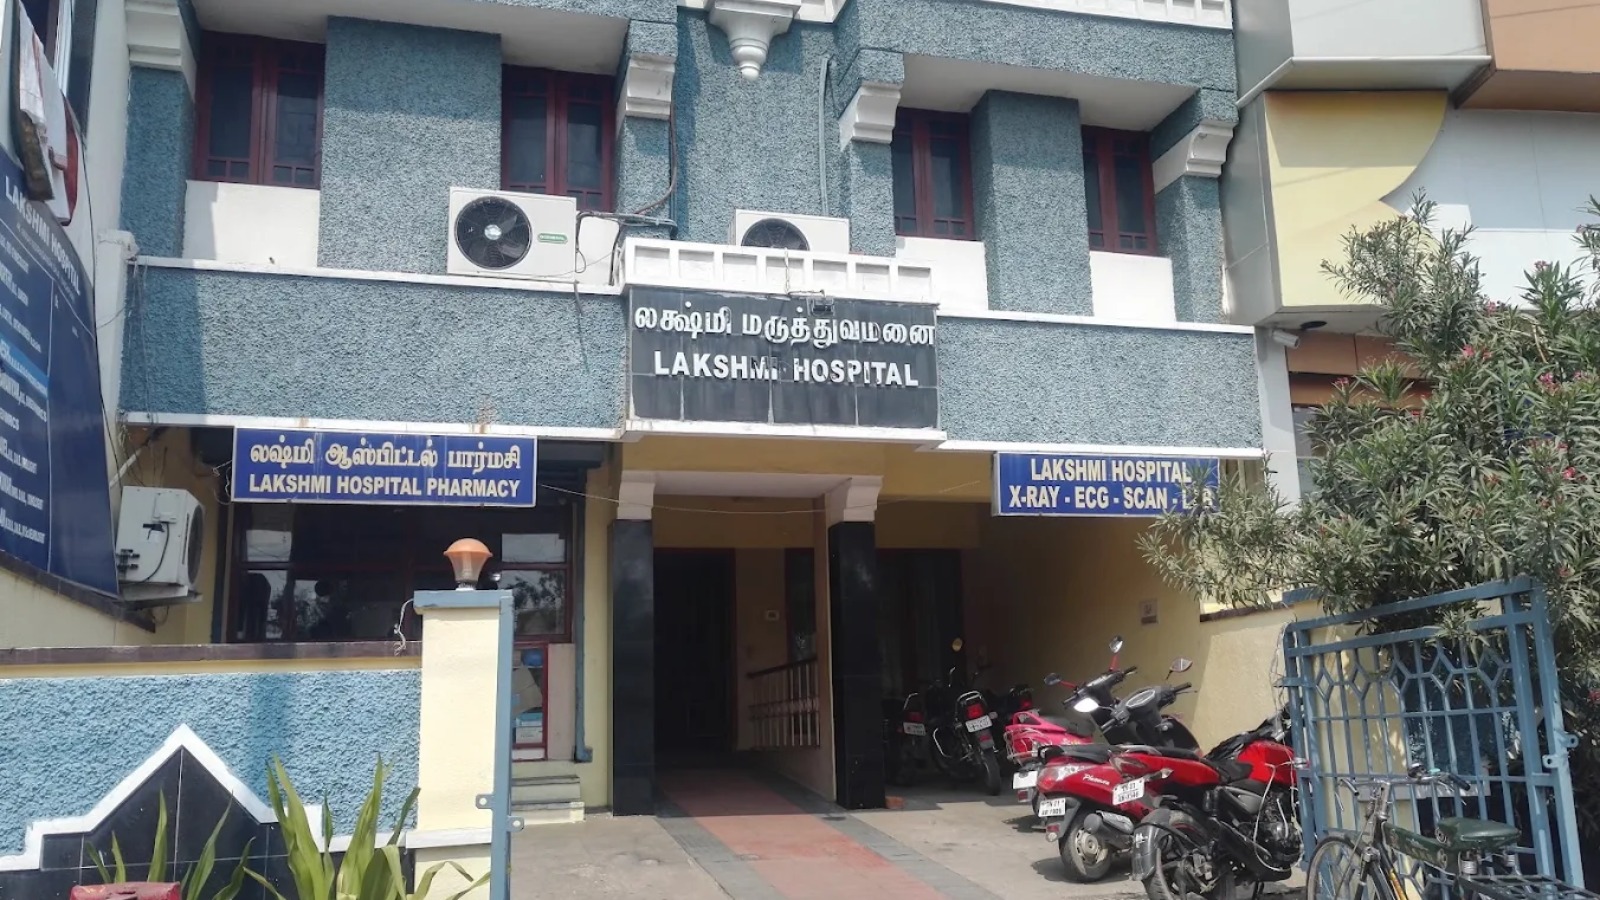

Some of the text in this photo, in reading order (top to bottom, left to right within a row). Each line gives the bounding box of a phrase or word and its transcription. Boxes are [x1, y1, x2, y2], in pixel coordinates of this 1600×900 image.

[653, 350, 919, 388] LAKSHMI HOSPITAL
[250, 435, 521, 475] லஷ்மி ஆஸ்பிட்டல் பார்மசி
[1030, 458, 1193, 484] LAKSHMI HOSPITAL
[249, 473, 521, 499] LAKSHMI HOSPITAL PHARMACY
[1008, 485, 1060, 508] X-RAY
[1075, 486, 1110, 509] ECG
[1123, 487, 1168, 510] SCAN
